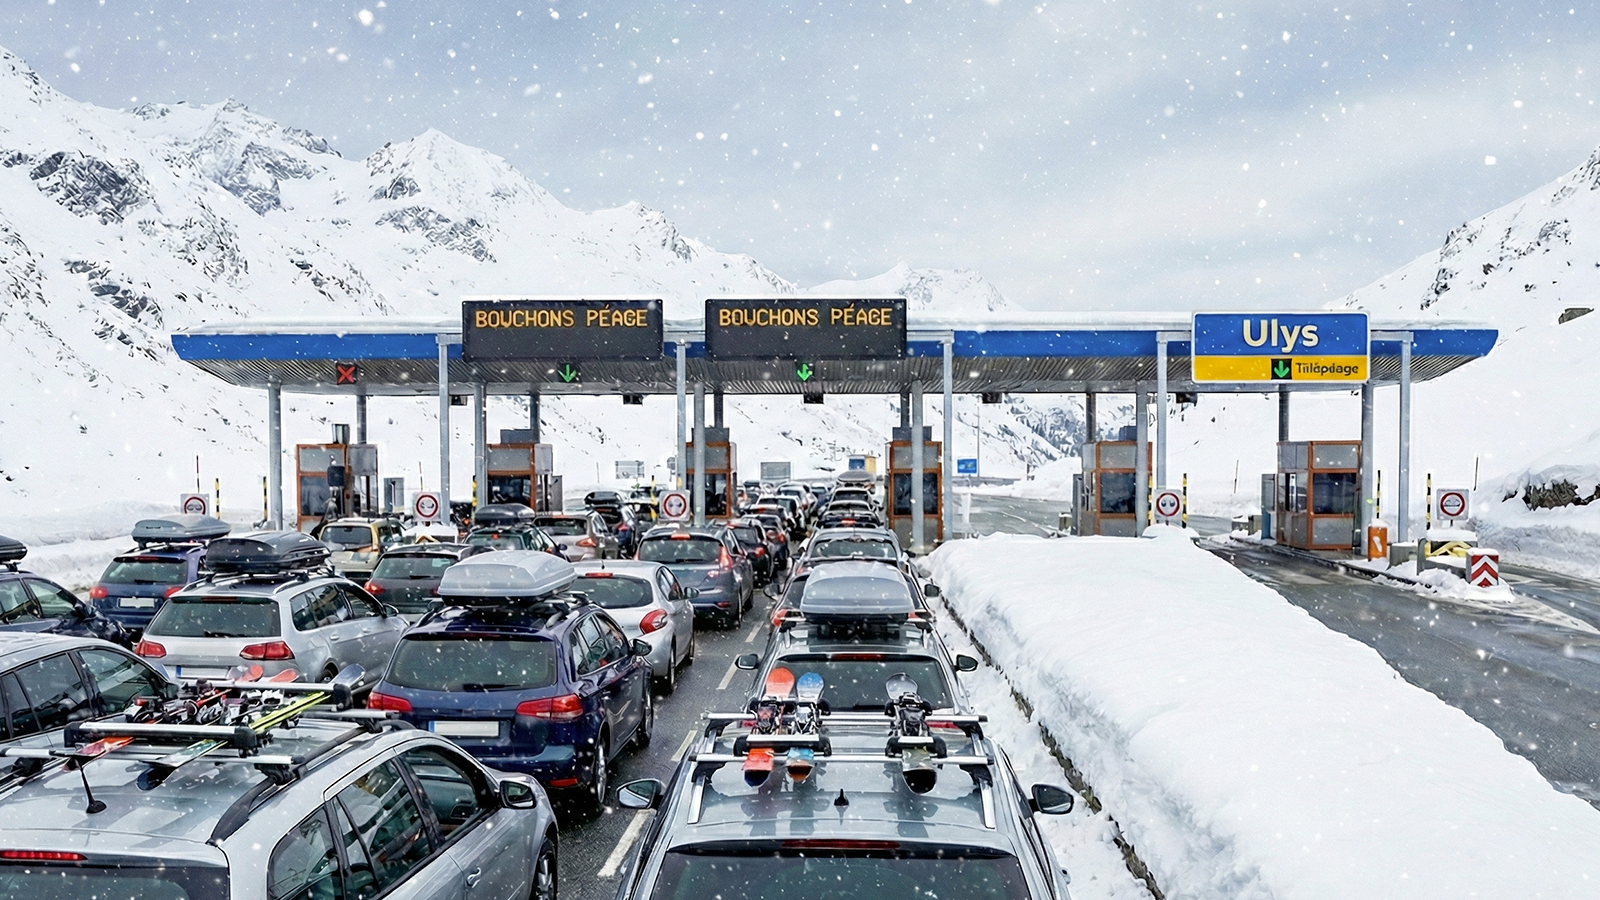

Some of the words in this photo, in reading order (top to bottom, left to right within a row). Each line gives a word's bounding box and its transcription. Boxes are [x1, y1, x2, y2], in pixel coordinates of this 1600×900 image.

[475, 310, 574, 328] BOUCHONS
[586, 304, 648, 327] PÉAGE
[719, 308, 819, 326] BOUCHONS
[831, 303, 893, 326] PÉAGE
[1243, 318, 1319, 353] Ulys
